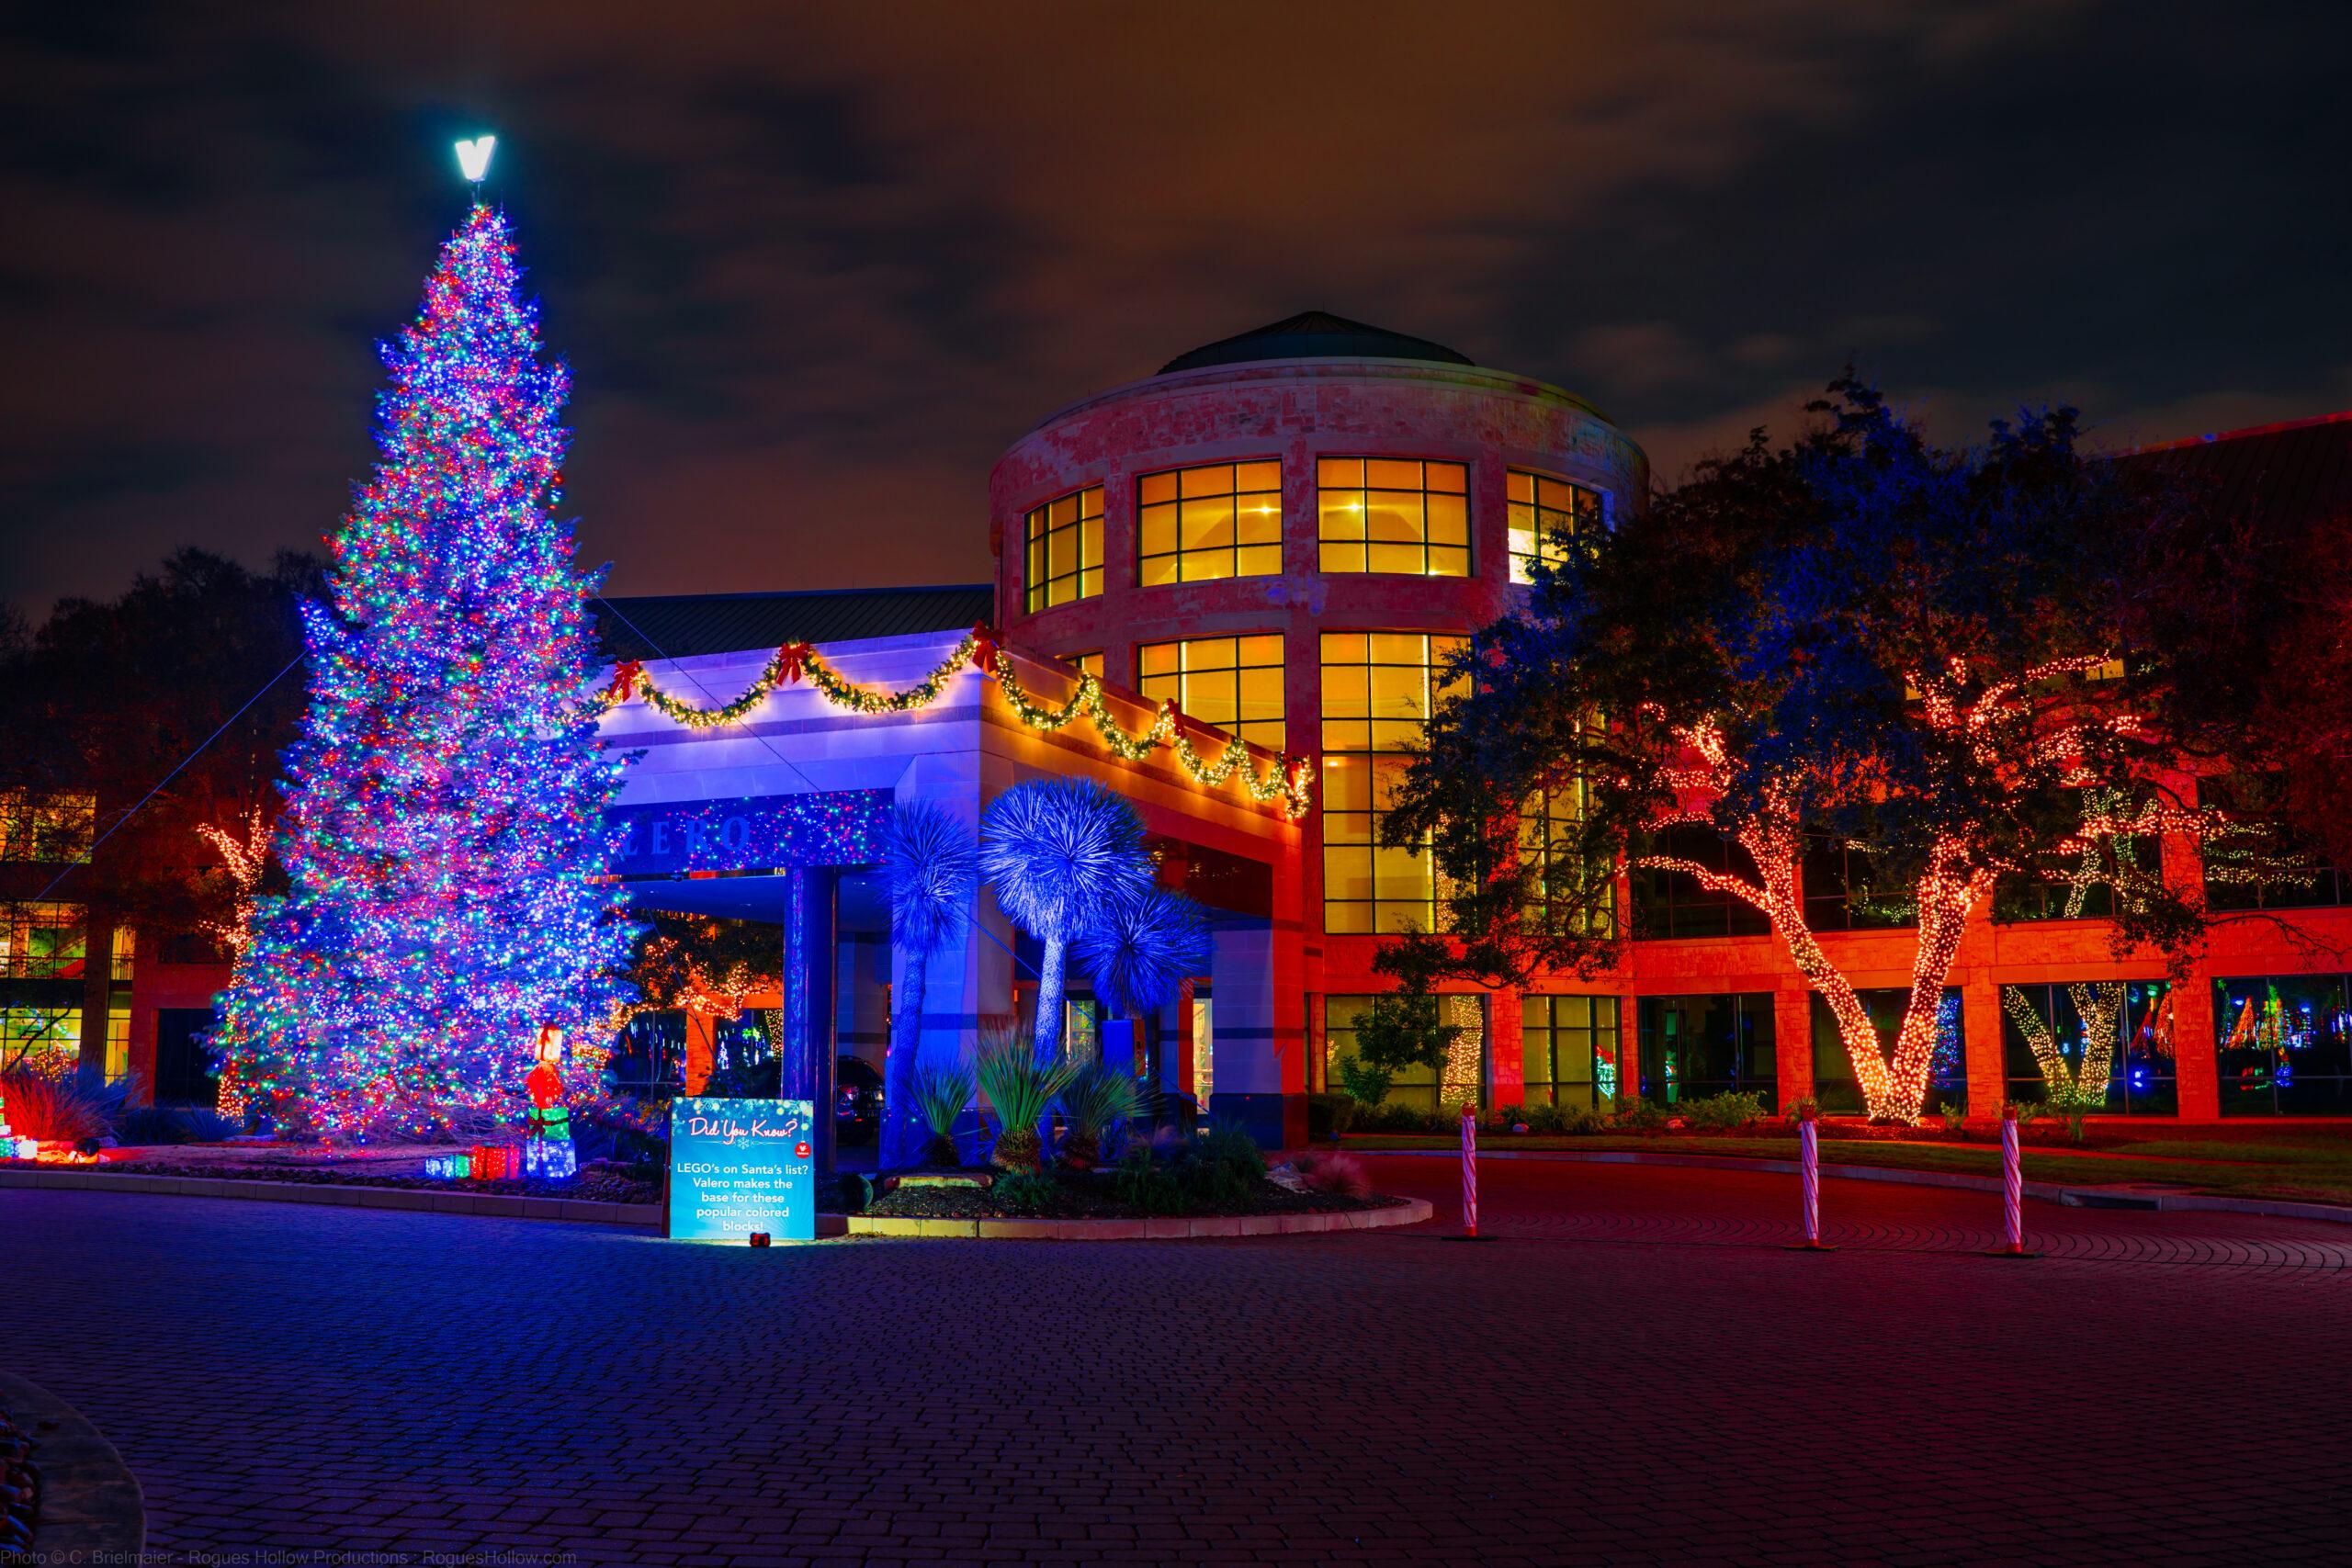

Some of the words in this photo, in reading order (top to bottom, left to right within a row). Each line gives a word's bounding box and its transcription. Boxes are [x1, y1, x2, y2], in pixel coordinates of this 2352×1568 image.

[689, 1117, 719, 1136] Did
[723, 1120, 748, 1145] You
[752, 1120, 797, 1137] Know?
[677, 1163, 719, 1174] LEGO's
[723, 1166, 738, 1174] on
[741, 1165, 782, 1175] Santa's
[786, 1165, 808, 1175] list?
[693, 1178, 729, 1188] Valero
[734, 1179, 770, 1189] makes
[774, 1179, 793, 1189] the
[702, 1191, 729, 1202] base
[732, 1192, 749, 1202] for
[753, 1193, 784, 1202] these
[696, 1206, 741, 1219] popular
[746, 1207, 789, 1217] colored
[723, 1221, 763, 1231] blocks!
